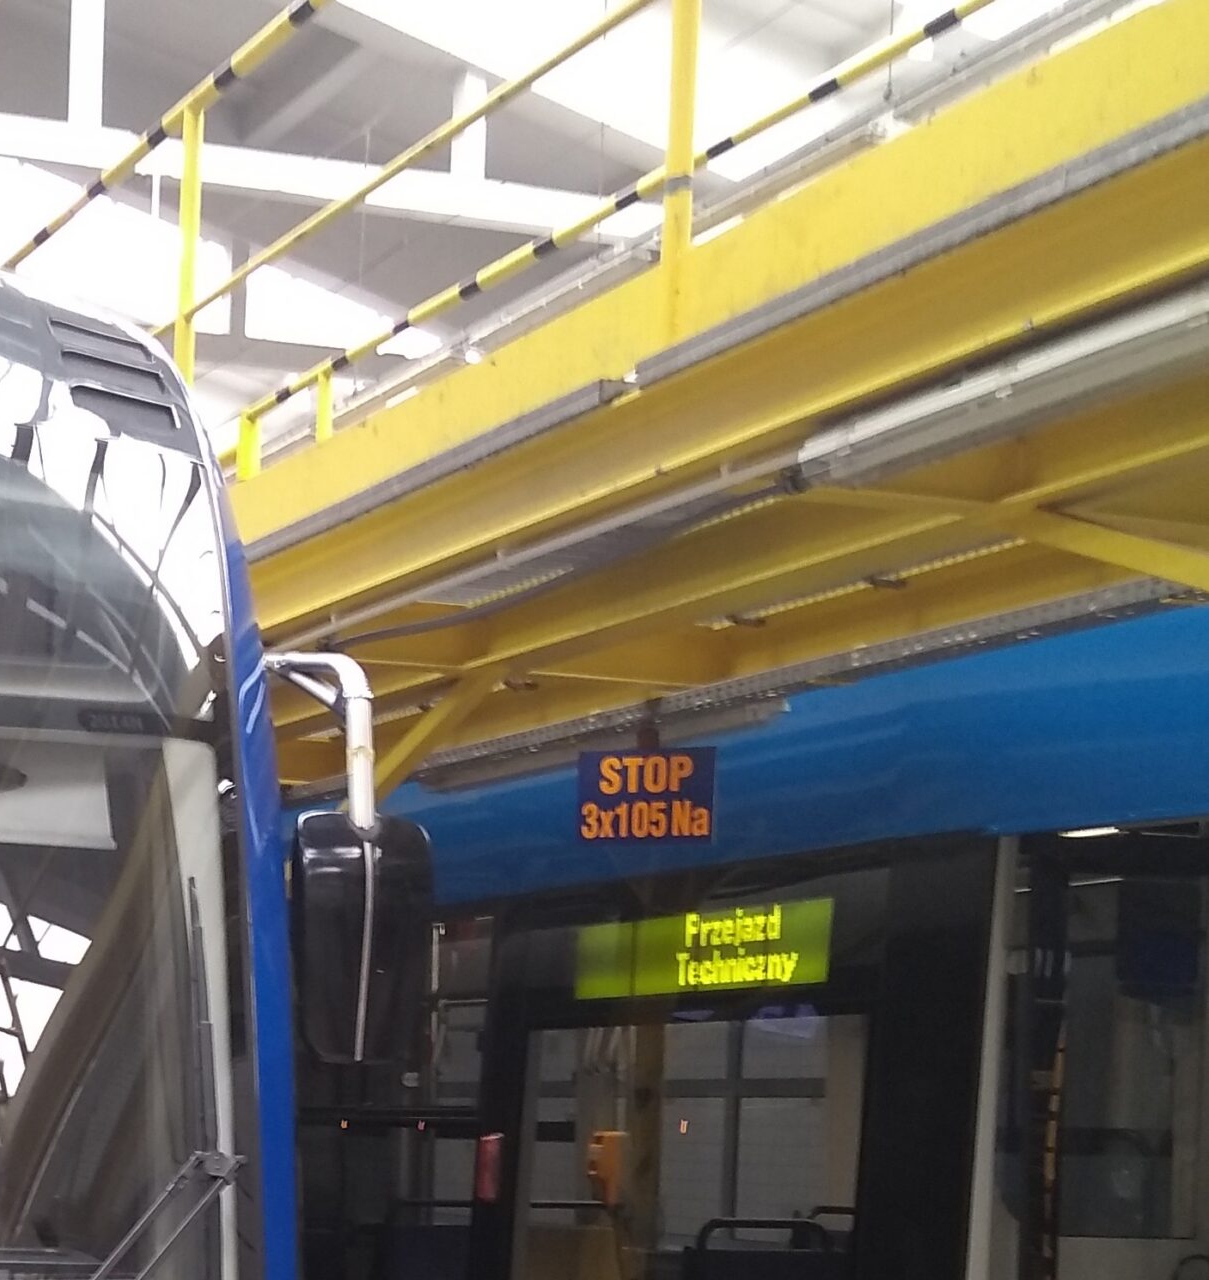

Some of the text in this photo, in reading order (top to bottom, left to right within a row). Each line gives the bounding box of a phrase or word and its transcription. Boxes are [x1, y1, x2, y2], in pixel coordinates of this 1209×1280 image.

[599, 755, 694, 795] STOP
[581, 799, 710, 839] 3x105 Na
[685, 904, 781, 947] Przejazd
[676, 948, 799, 985] Techniczny
